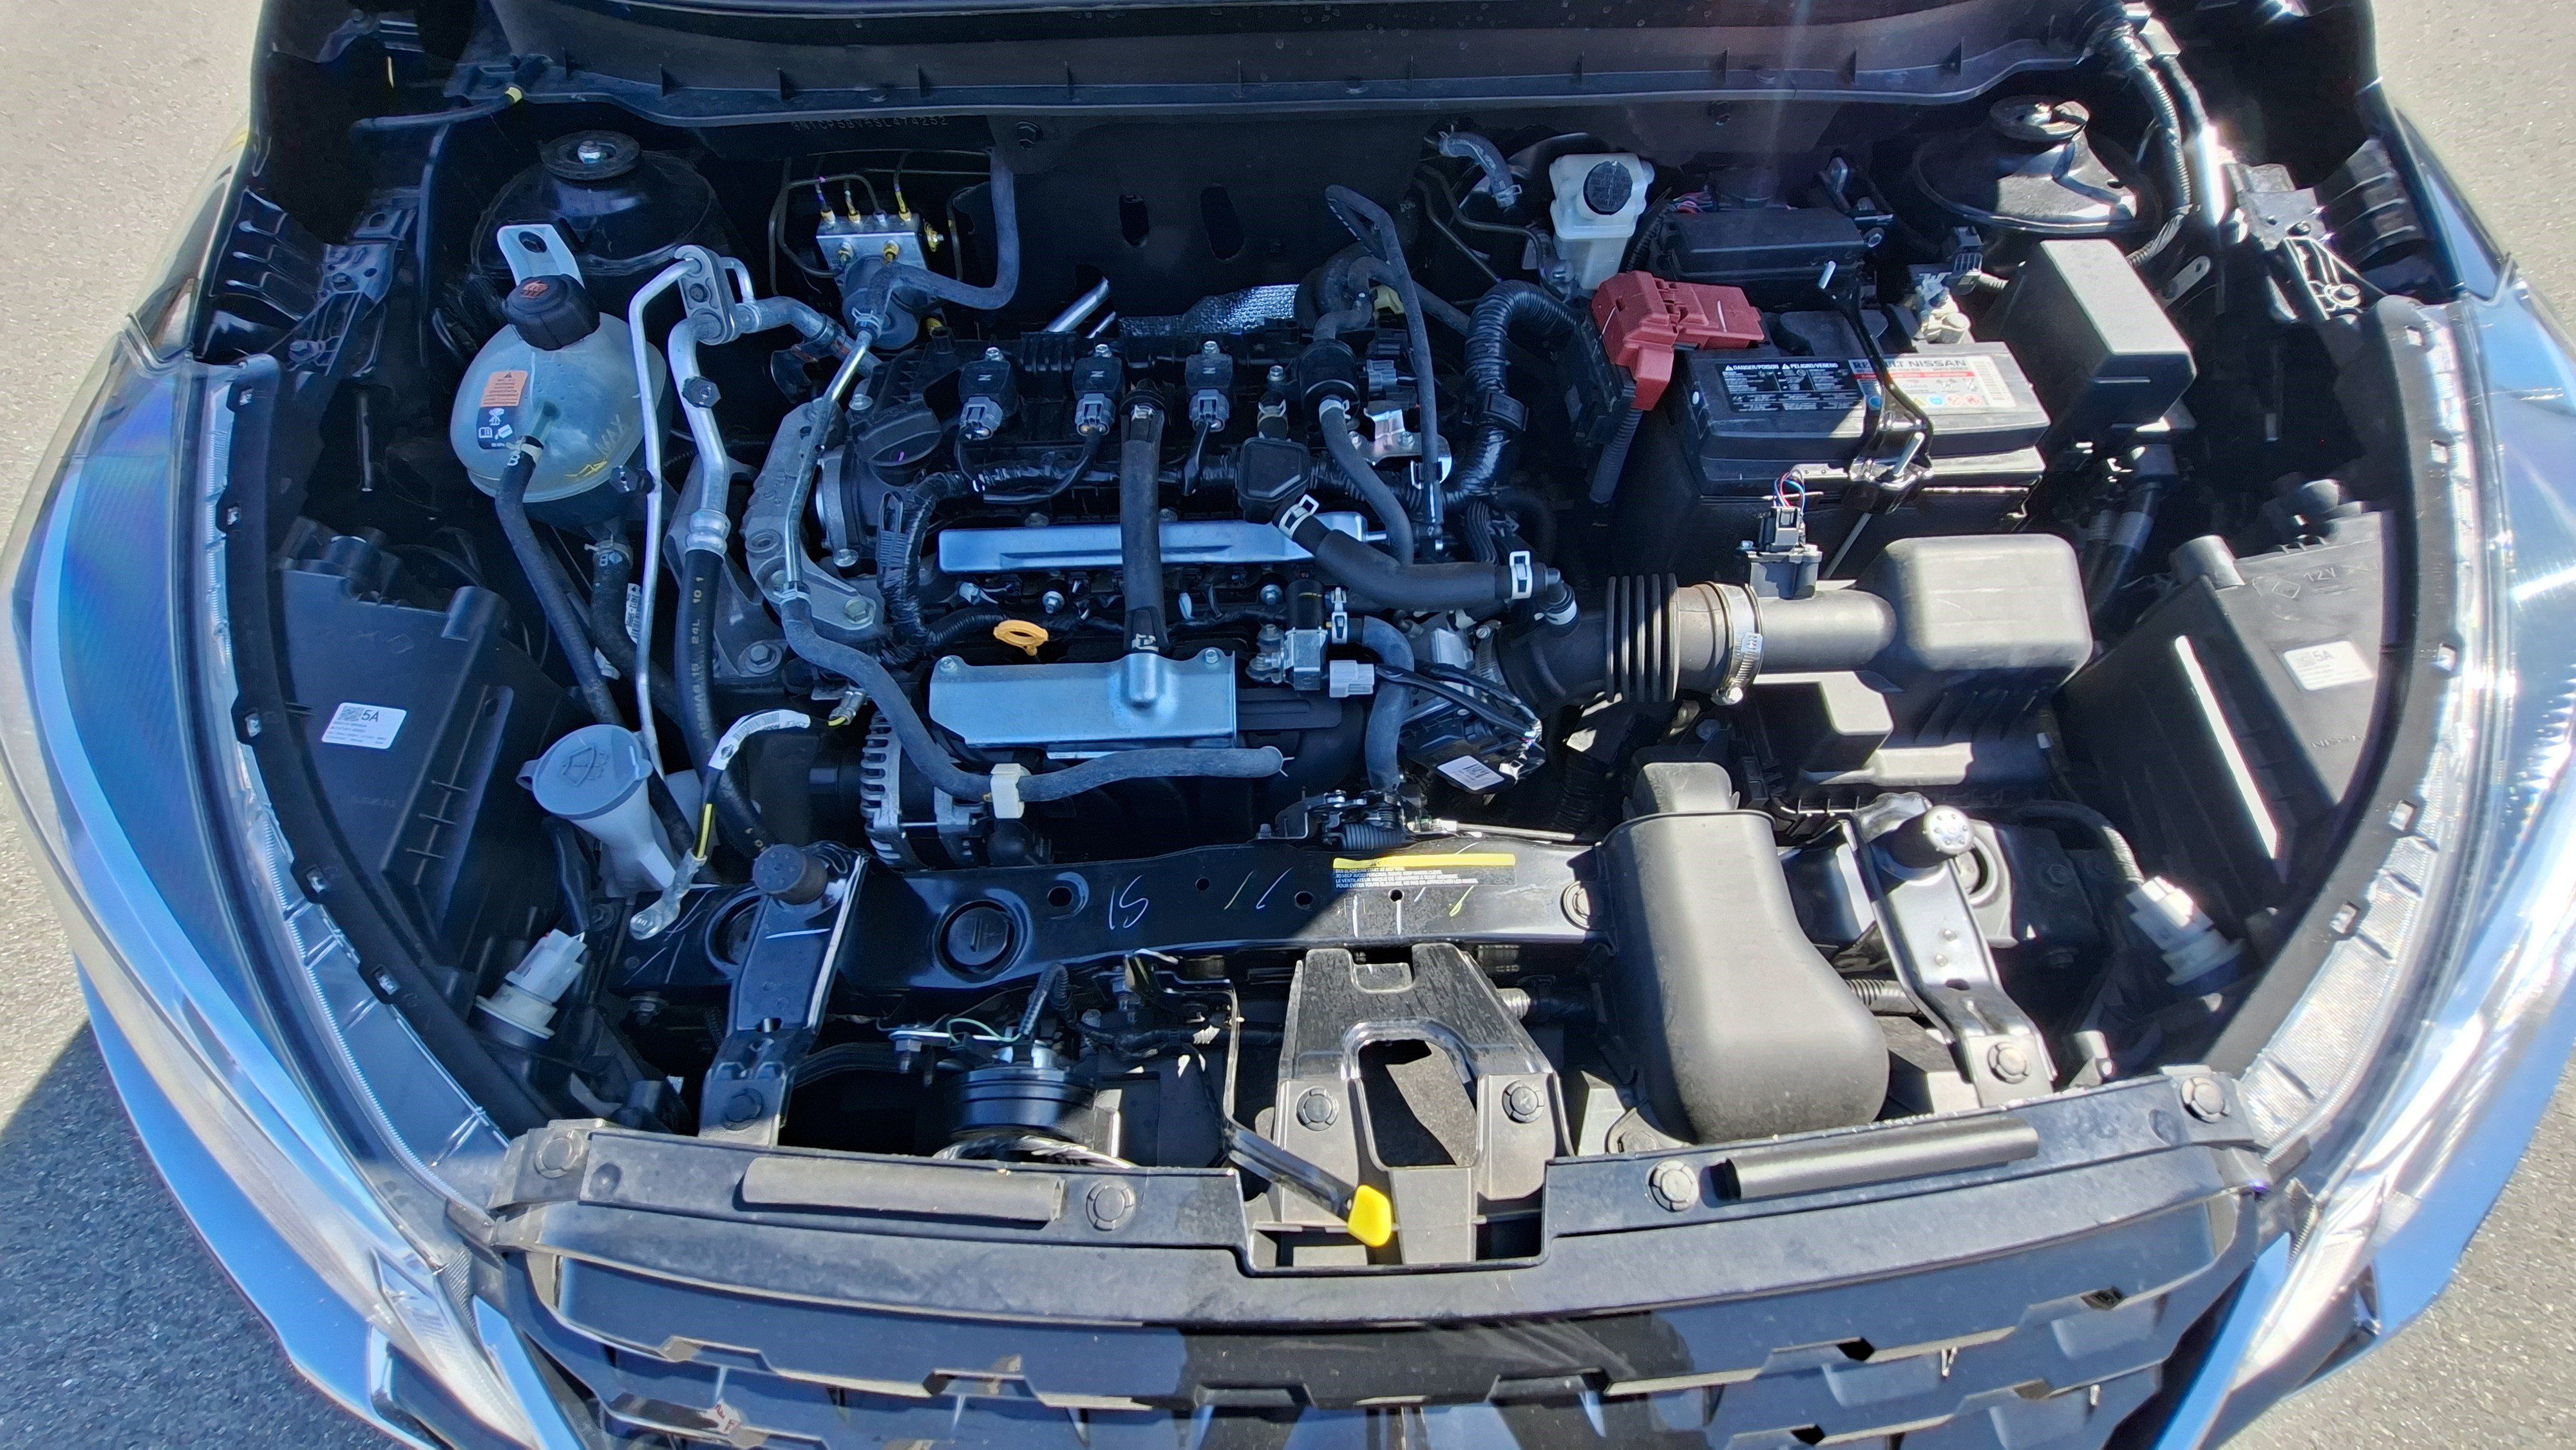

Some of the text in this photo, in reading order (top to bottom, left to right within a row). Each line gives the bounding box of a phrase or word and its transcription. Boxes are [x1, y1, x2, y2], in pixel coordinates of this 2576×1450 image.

[594, 413, 623, 456] MAX
[507, 453, 520, 467] B
[691, 619, 701, 644] 24L
[2313, 650, 2334, 662] 5A
[361, 710, 380, 722] 5A
